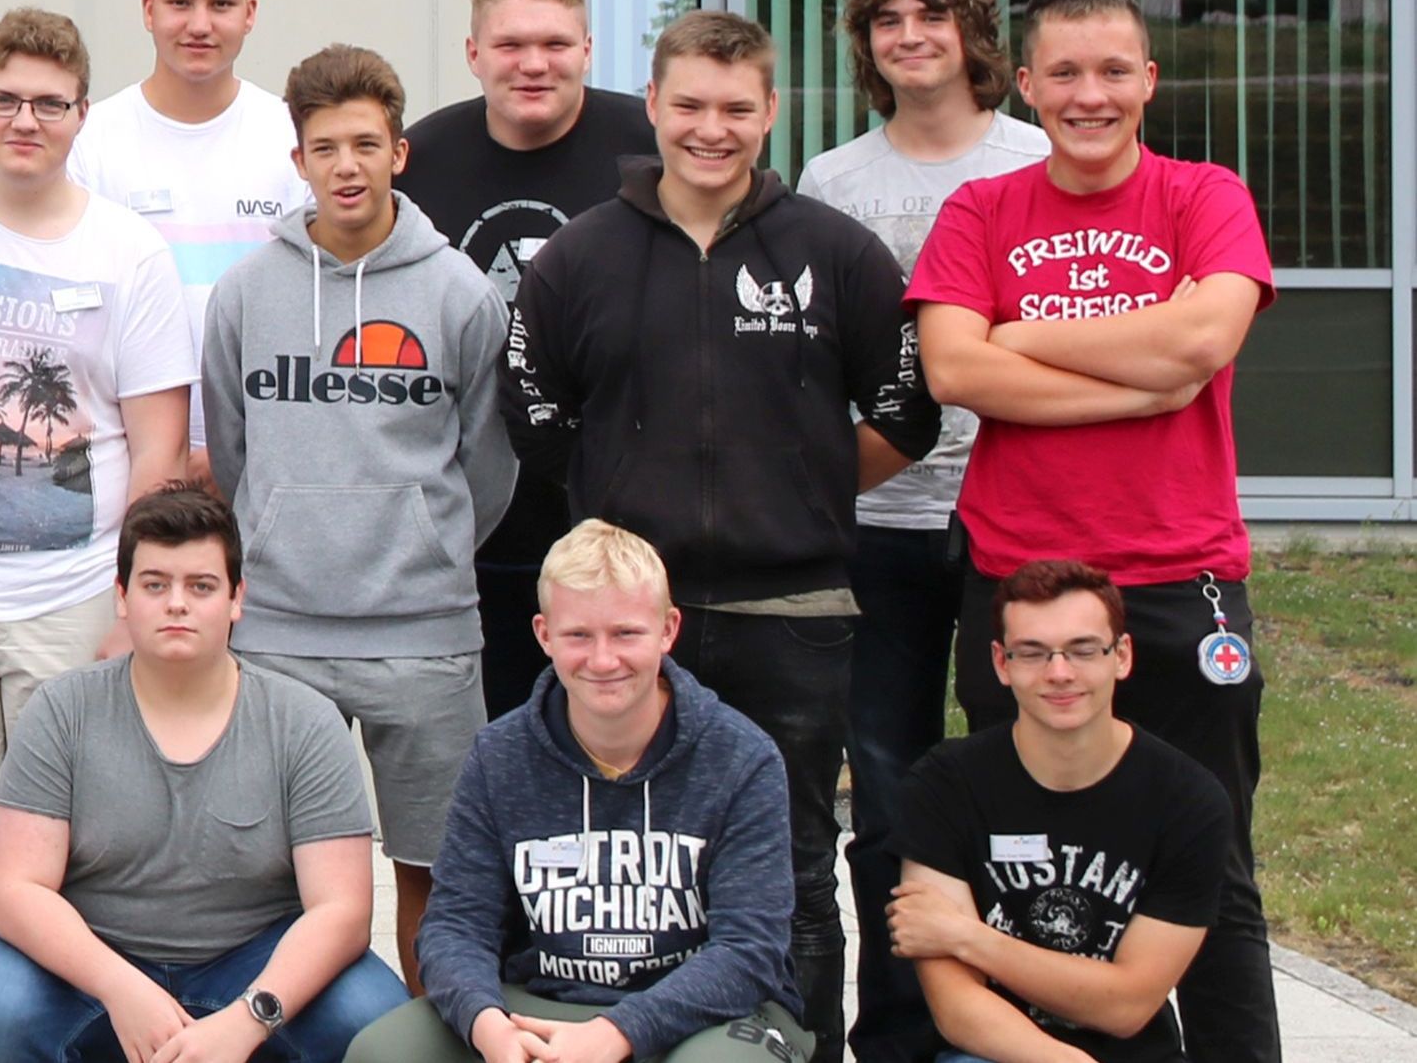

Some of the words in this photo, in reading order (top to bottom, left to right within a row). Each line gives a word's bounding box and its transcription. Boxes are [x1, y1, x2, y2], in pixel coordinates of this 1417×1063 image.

[236, 199, 283, 216] NASA
[1008, 229, 1171, 277] FREIWILD
[1068, 263, 1109, 290] ist
[245, 354, 442, 406] ellesse
[520, 885, 707, 934] MICHIGAN
[590, 938, 647, 954] IGNITION
[539, 950, 621, 985] MOTOR
